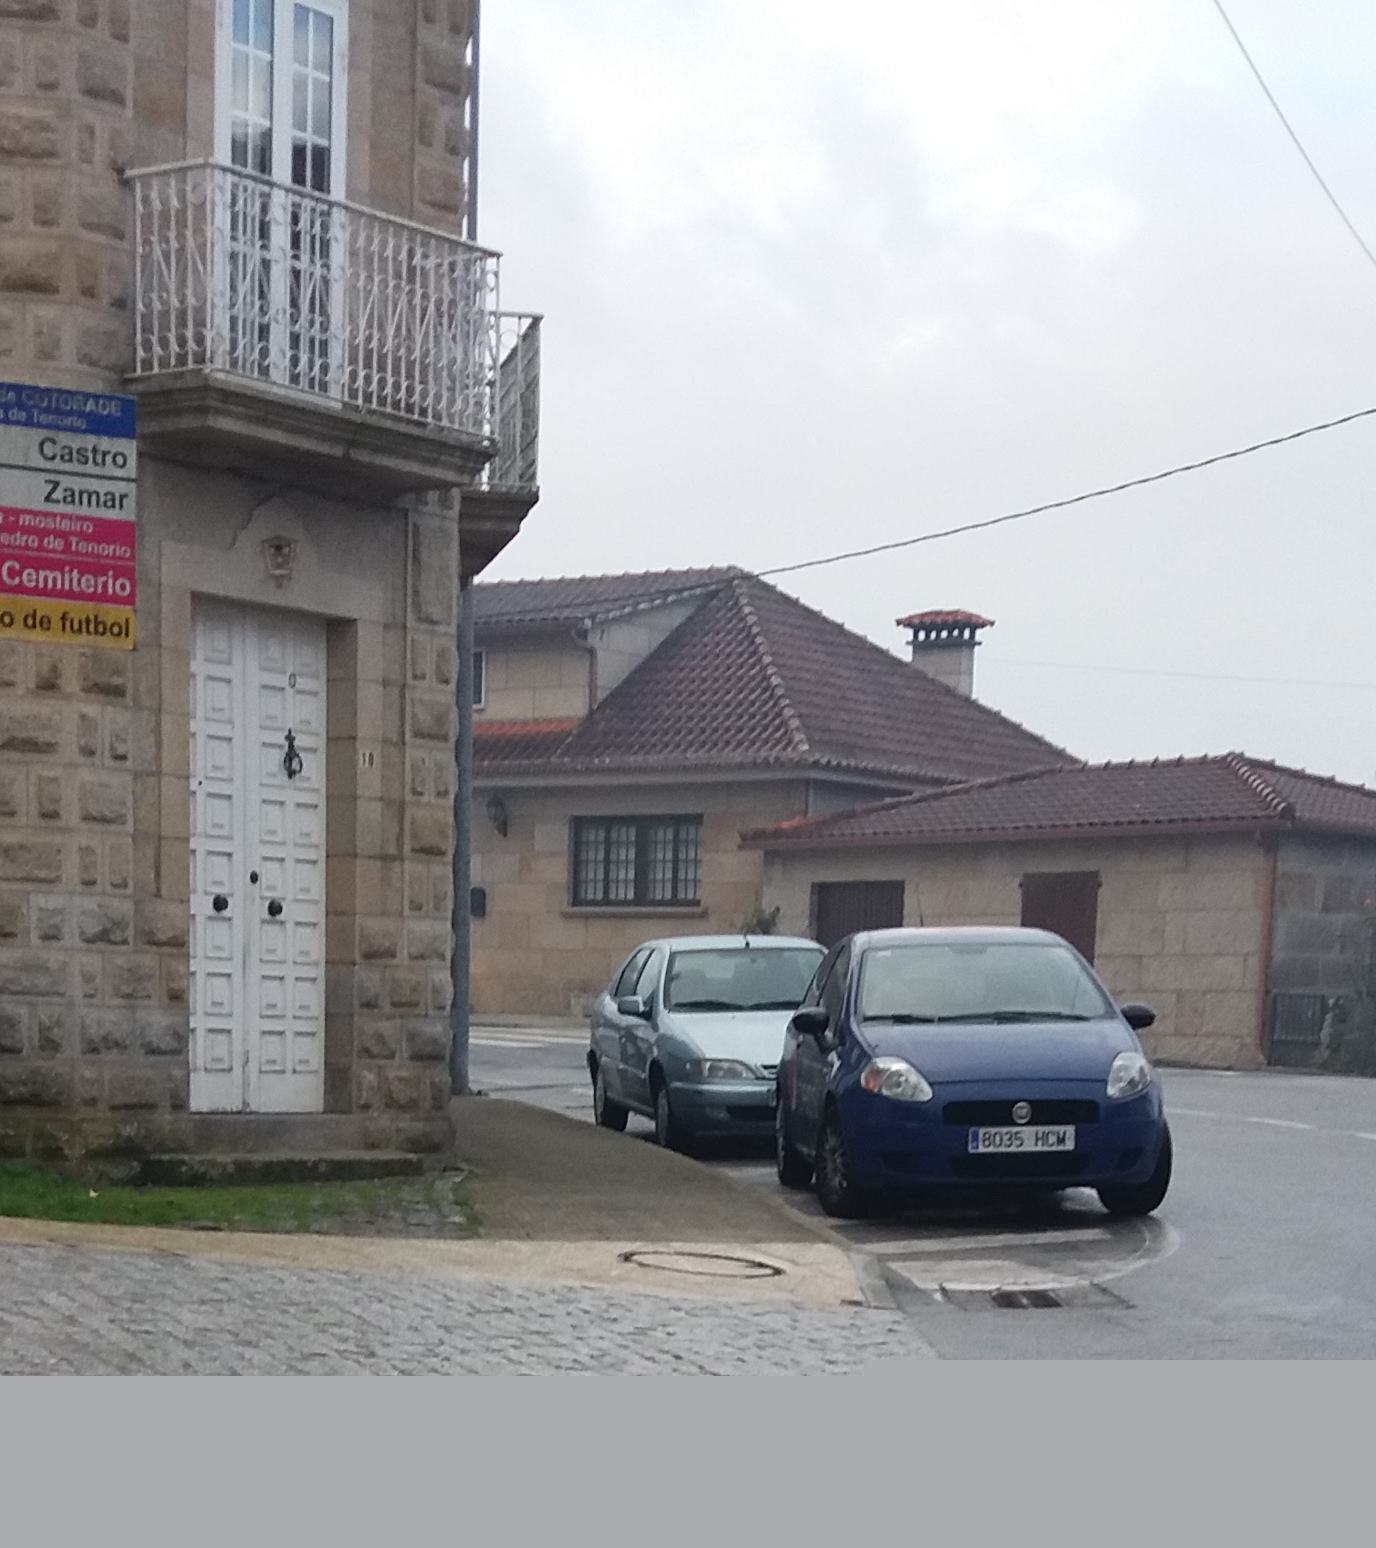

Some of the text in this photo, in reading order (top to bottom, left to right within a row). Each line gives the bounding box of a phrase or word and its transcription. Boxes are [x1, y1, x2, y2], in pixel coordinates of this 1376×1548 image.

[8, 407, 27, 421] de
[32, 409, 87, 429] Tenorio
[38, 437, 128, 469] Castro
[43, 480, 129, 510] Zamar
[19, 513, 94, 534] mosteiro
[44, 534, 65, 551] de
[69, 536, 131, 558] Tenorio
[1, 560, 131, 597] Cemiterio
[23, 609, 52, 631] de
[61, 611, 130, 638] futbol
[982, 1130, 1024, 1149] 8035
